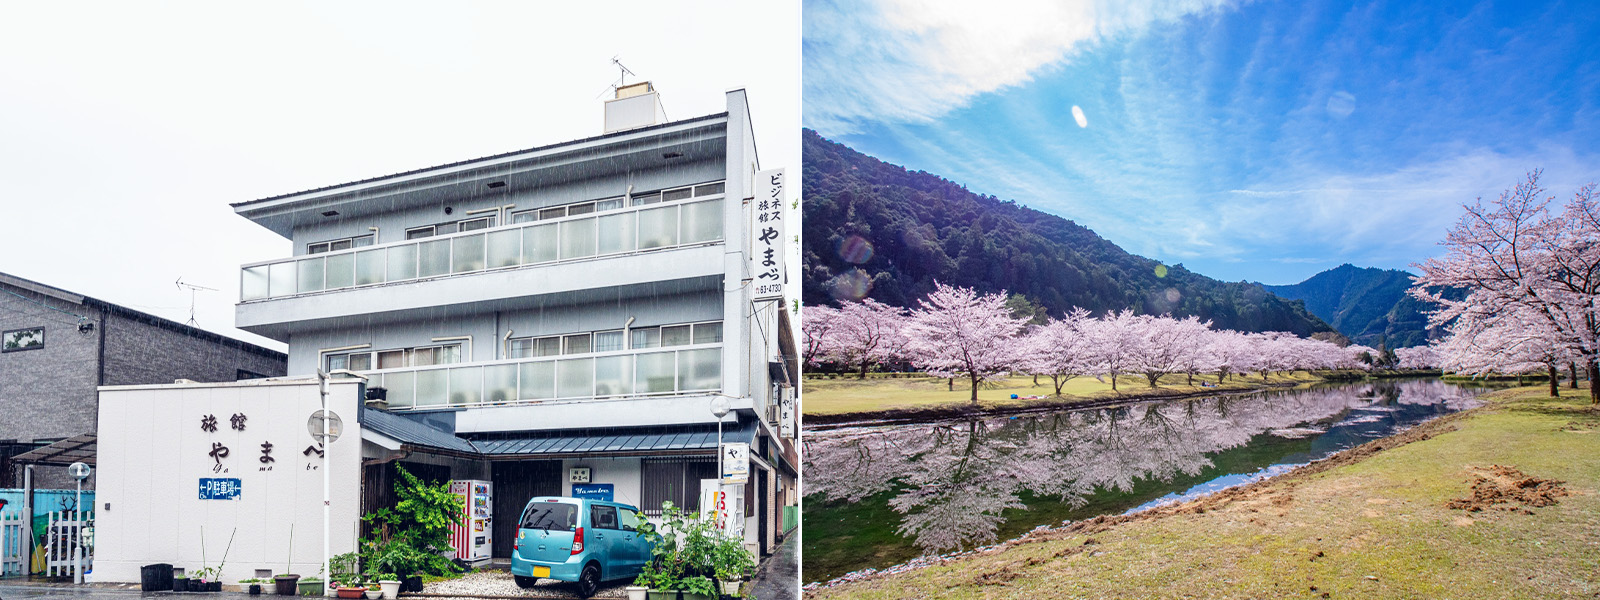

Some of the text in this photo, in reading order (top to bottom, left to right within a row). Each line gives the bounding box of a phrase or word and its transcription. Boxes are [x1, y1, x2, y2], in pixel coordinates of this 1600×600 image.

[758, 200, 769, 223] 旅館
[770, 173, 782, 221] ビジネス
[758, 226, 780, 280] やまべ
[201, 412, 247, 432] 旅館
